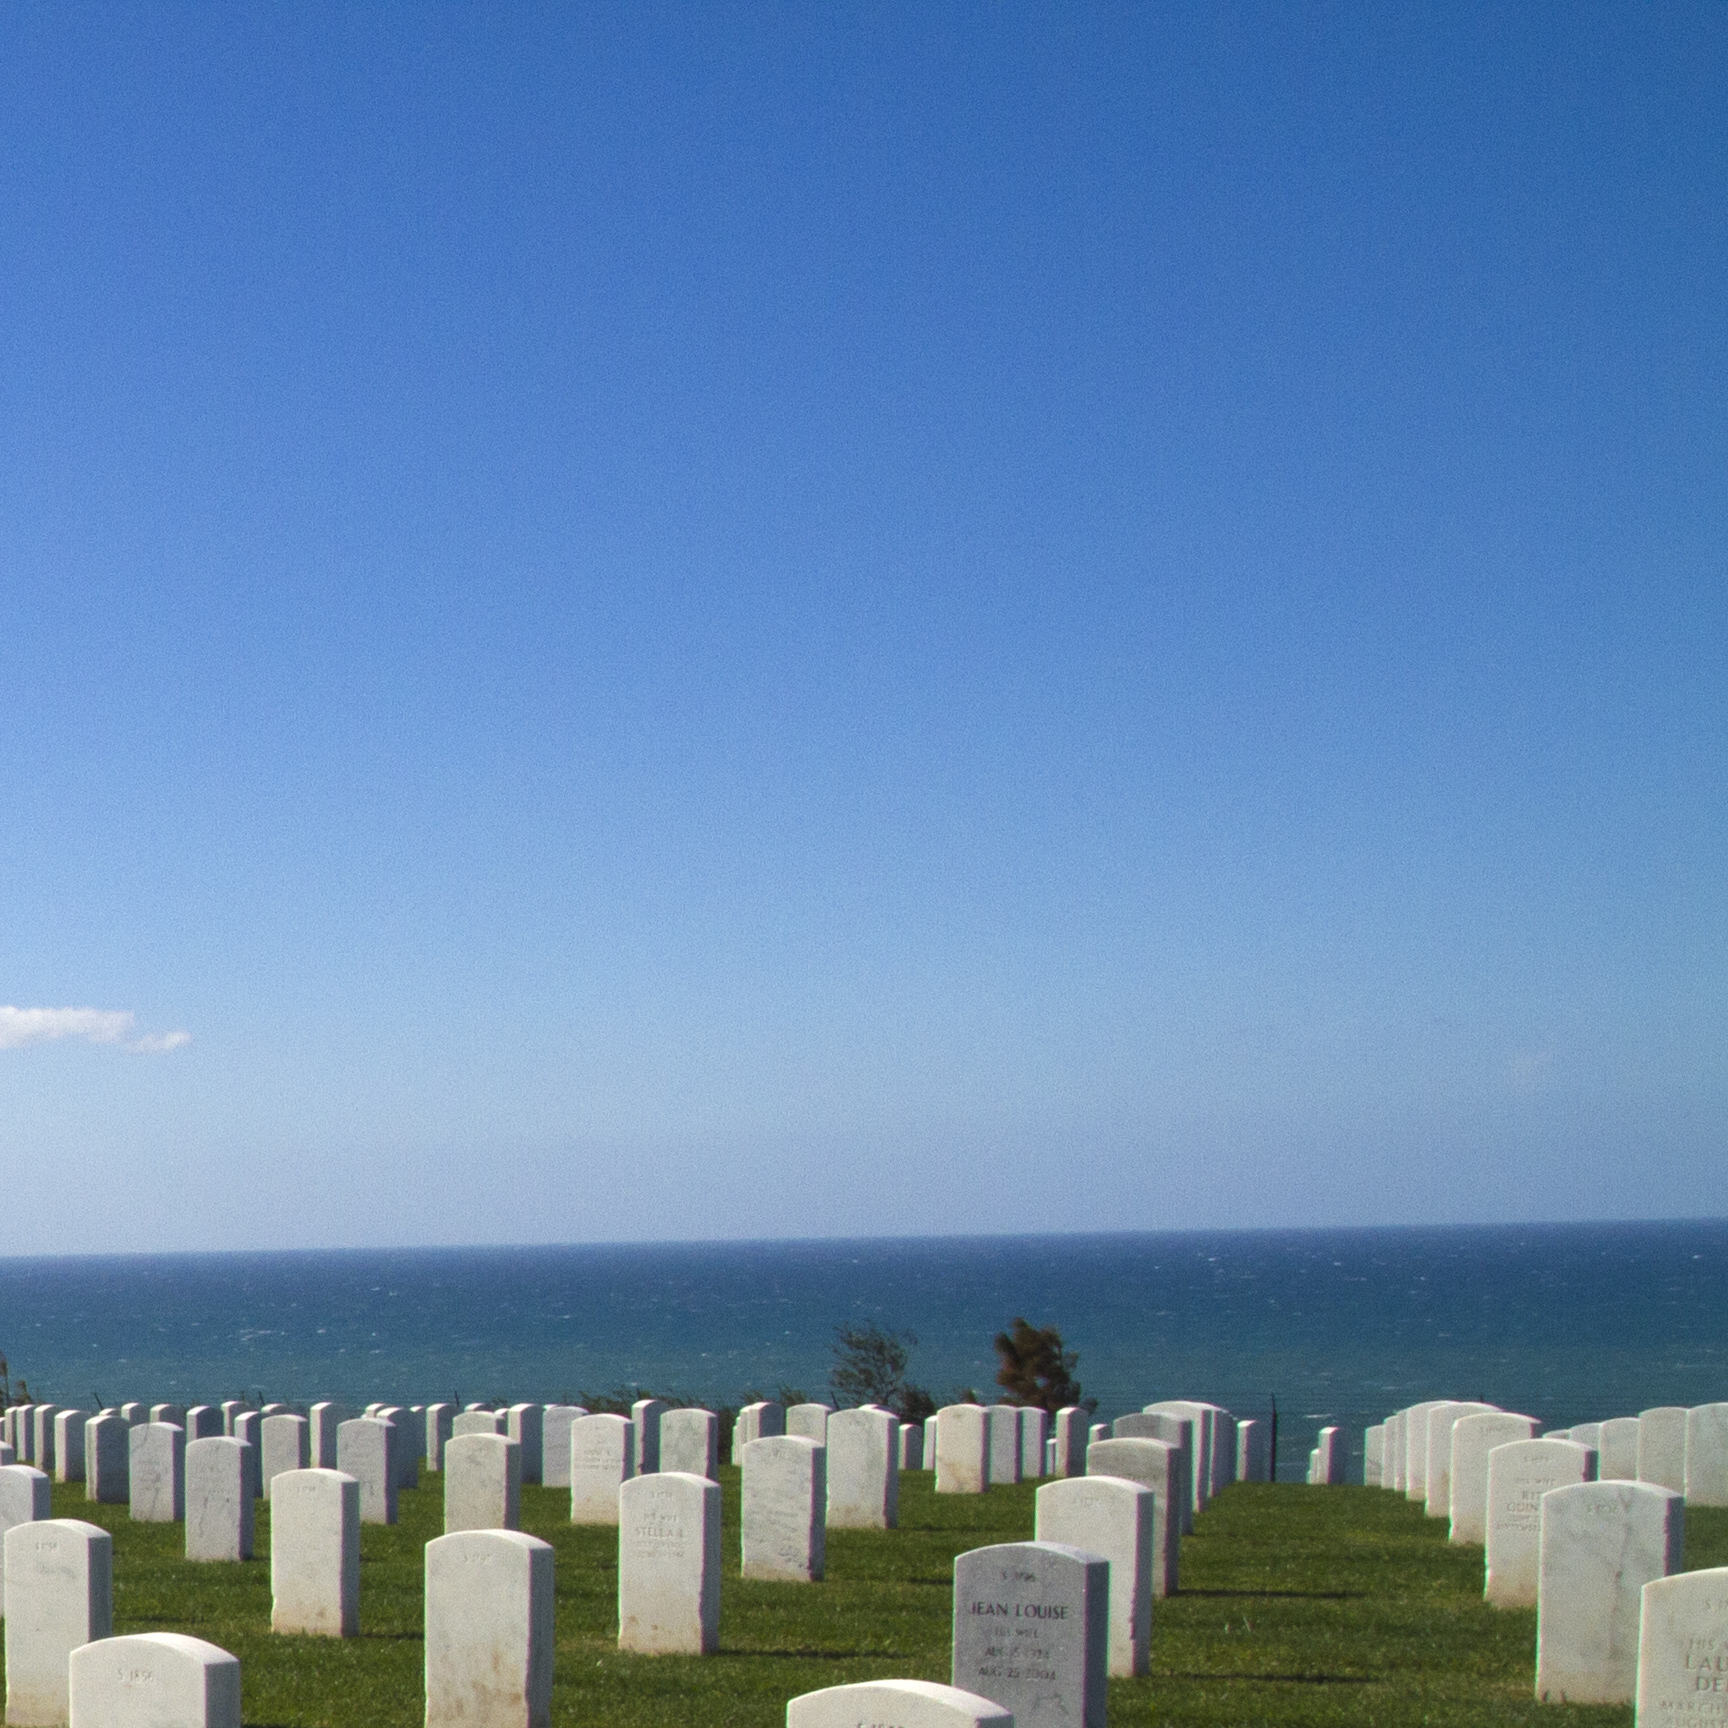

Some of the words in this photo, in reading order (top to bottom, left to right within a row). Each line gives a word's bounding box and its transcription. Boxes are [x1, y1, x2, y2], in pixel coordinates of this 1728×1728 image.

[968, 1602, 1008, 1617] JEAN
[1016, 1604, 1068, 1620] LOUISE
[117, 1668, 124, 1680] S
